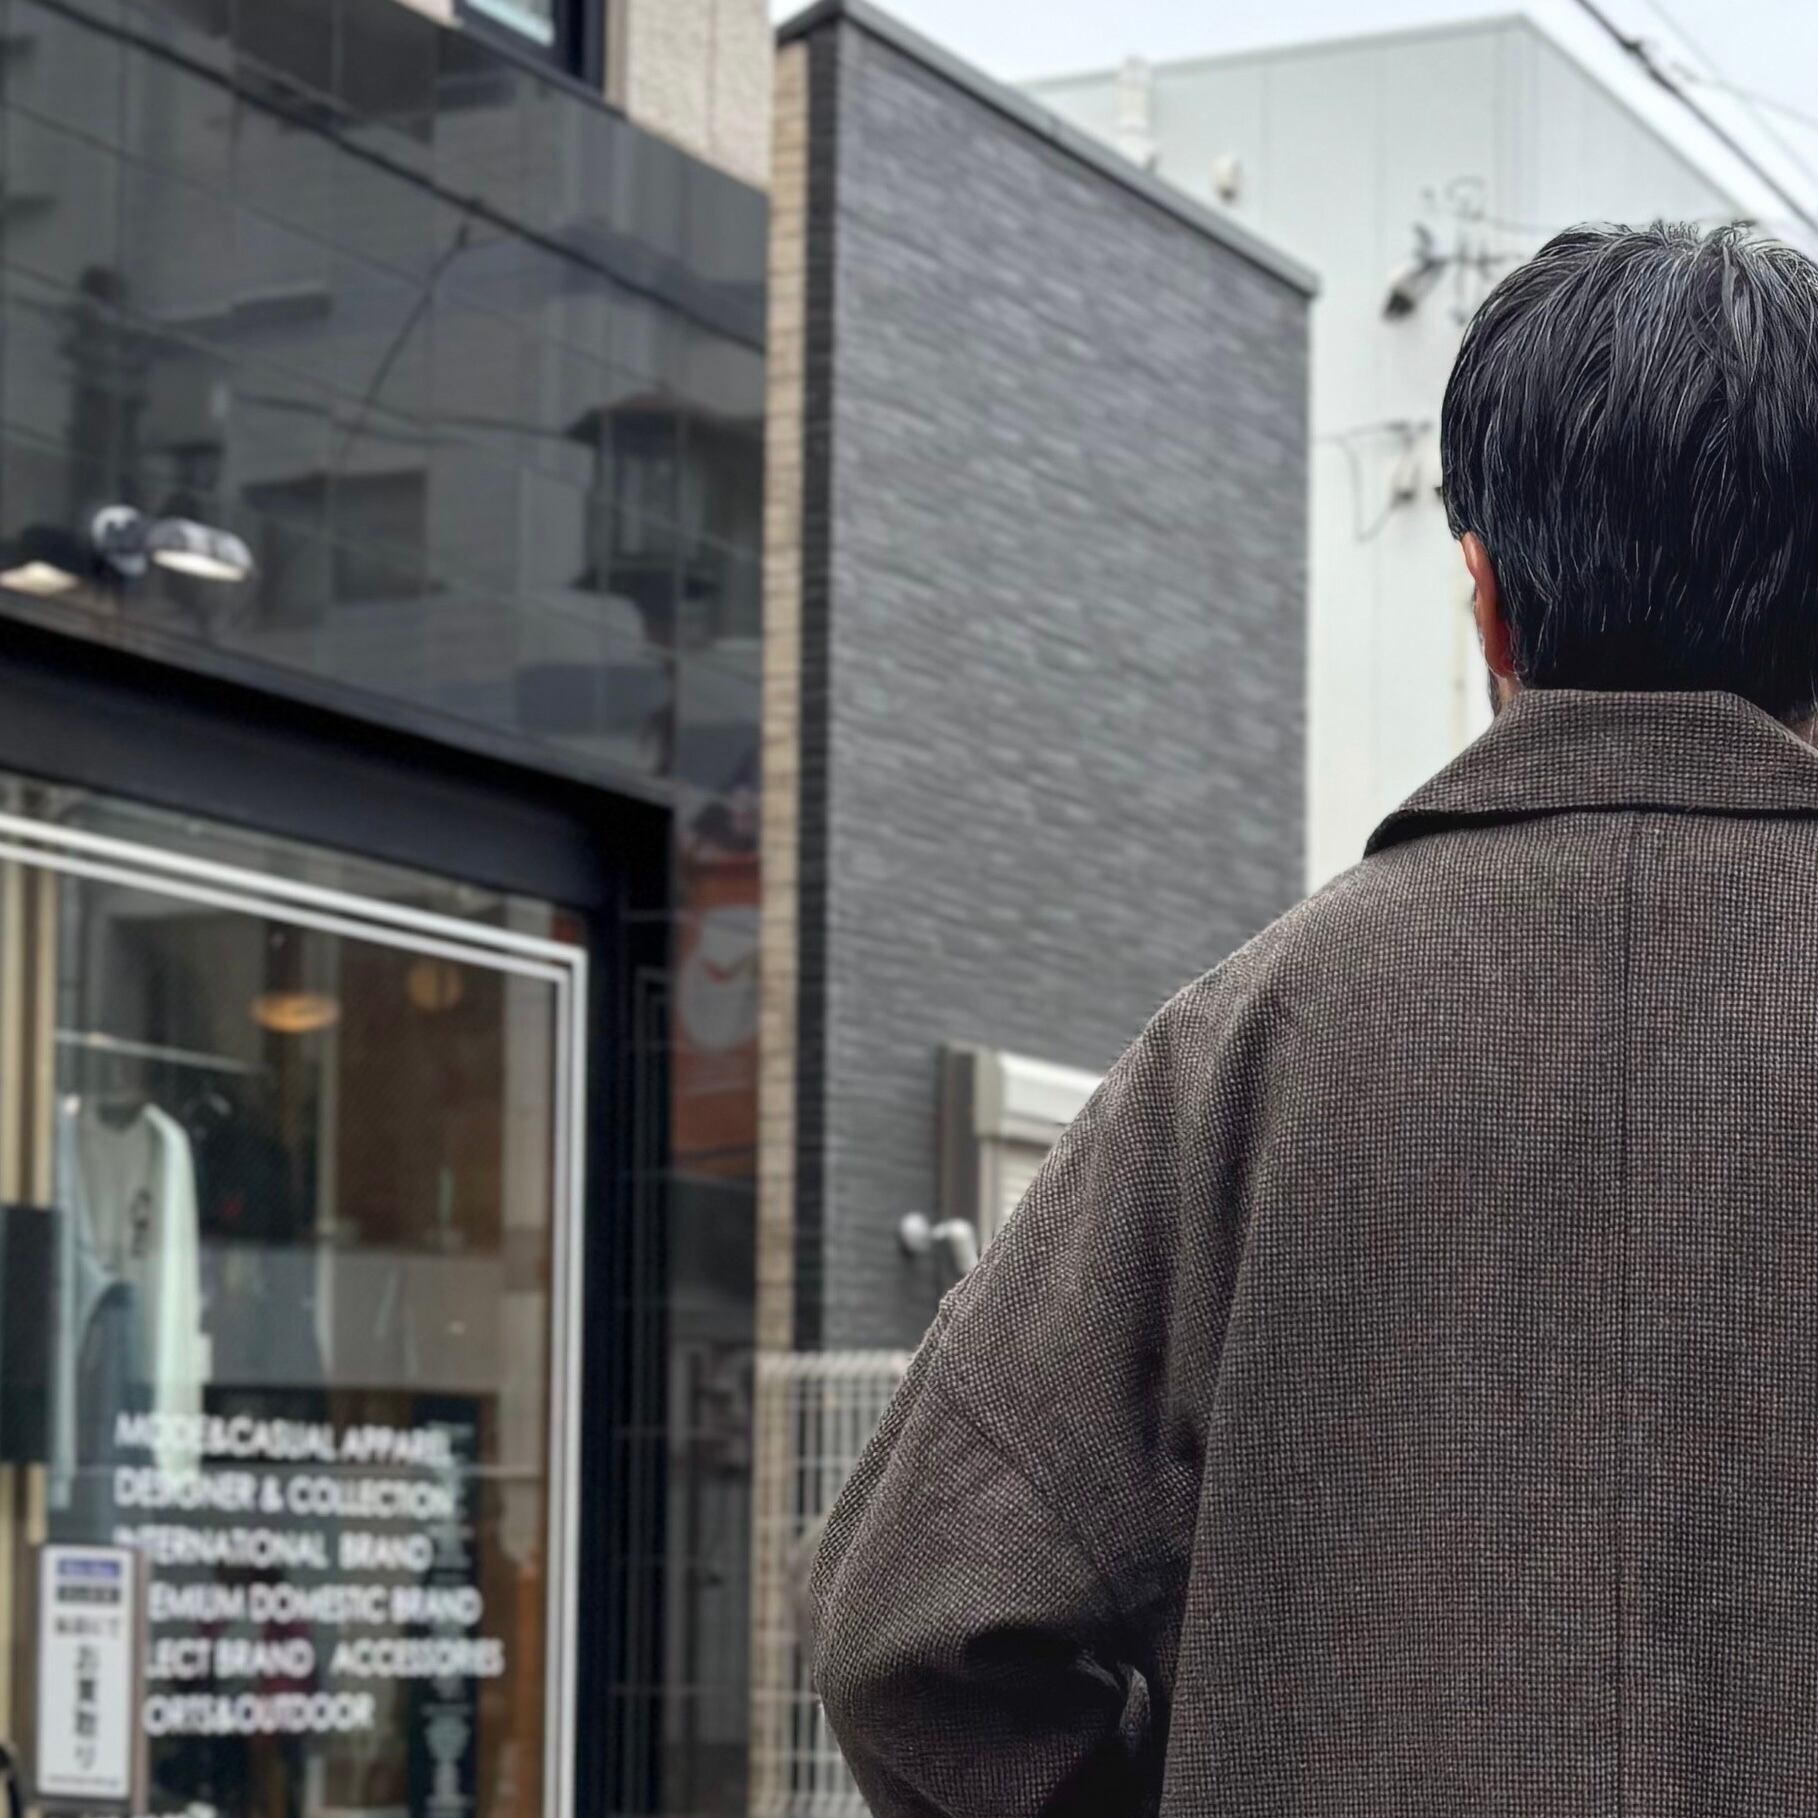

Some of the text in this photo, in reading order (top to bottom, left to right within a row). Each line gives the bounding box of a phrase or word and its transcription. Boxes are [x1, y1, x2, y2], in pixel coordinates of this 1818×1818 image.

[114, 1466, 256, 1510] DESIGNER
[287, 1474, 456, 1520] COLLECTION
[338, 1531, 434, 1571] BRAND
[391, 1586, 484, 1626] BRAND
[214, 1638, 316, 1680] BRAND
